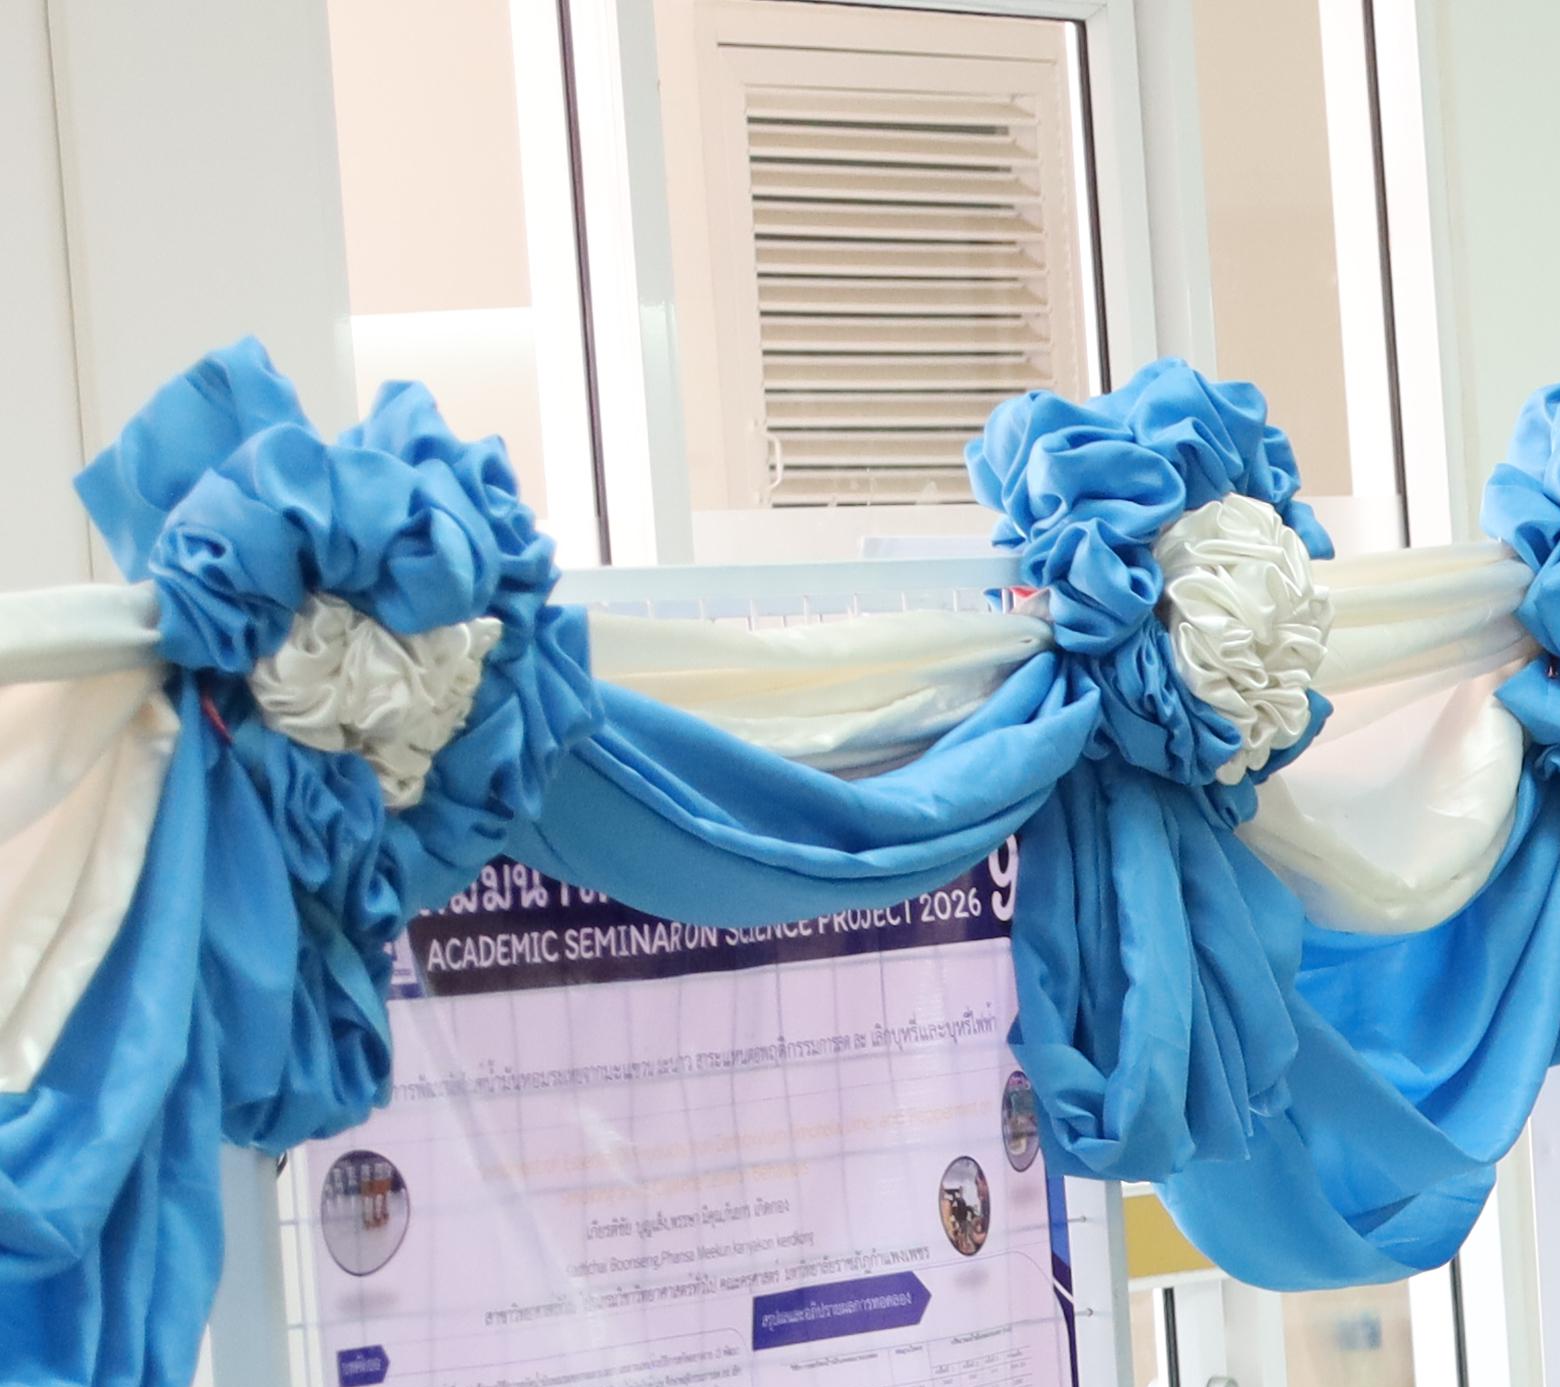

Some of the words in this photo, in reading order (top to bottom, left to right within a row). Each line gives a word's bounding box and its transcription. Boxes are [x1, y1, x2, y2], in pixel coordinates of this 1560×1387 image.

[988, 833, 1019, 921] 9
[427, 929, 560, 972] ACADEMIC
[564, 921, 682, 960] SEMINAR
[684, 923, 718, 951] ON
[818, 899, 912, 935] PROJECT
[919, 887, 982, 923] 2026
